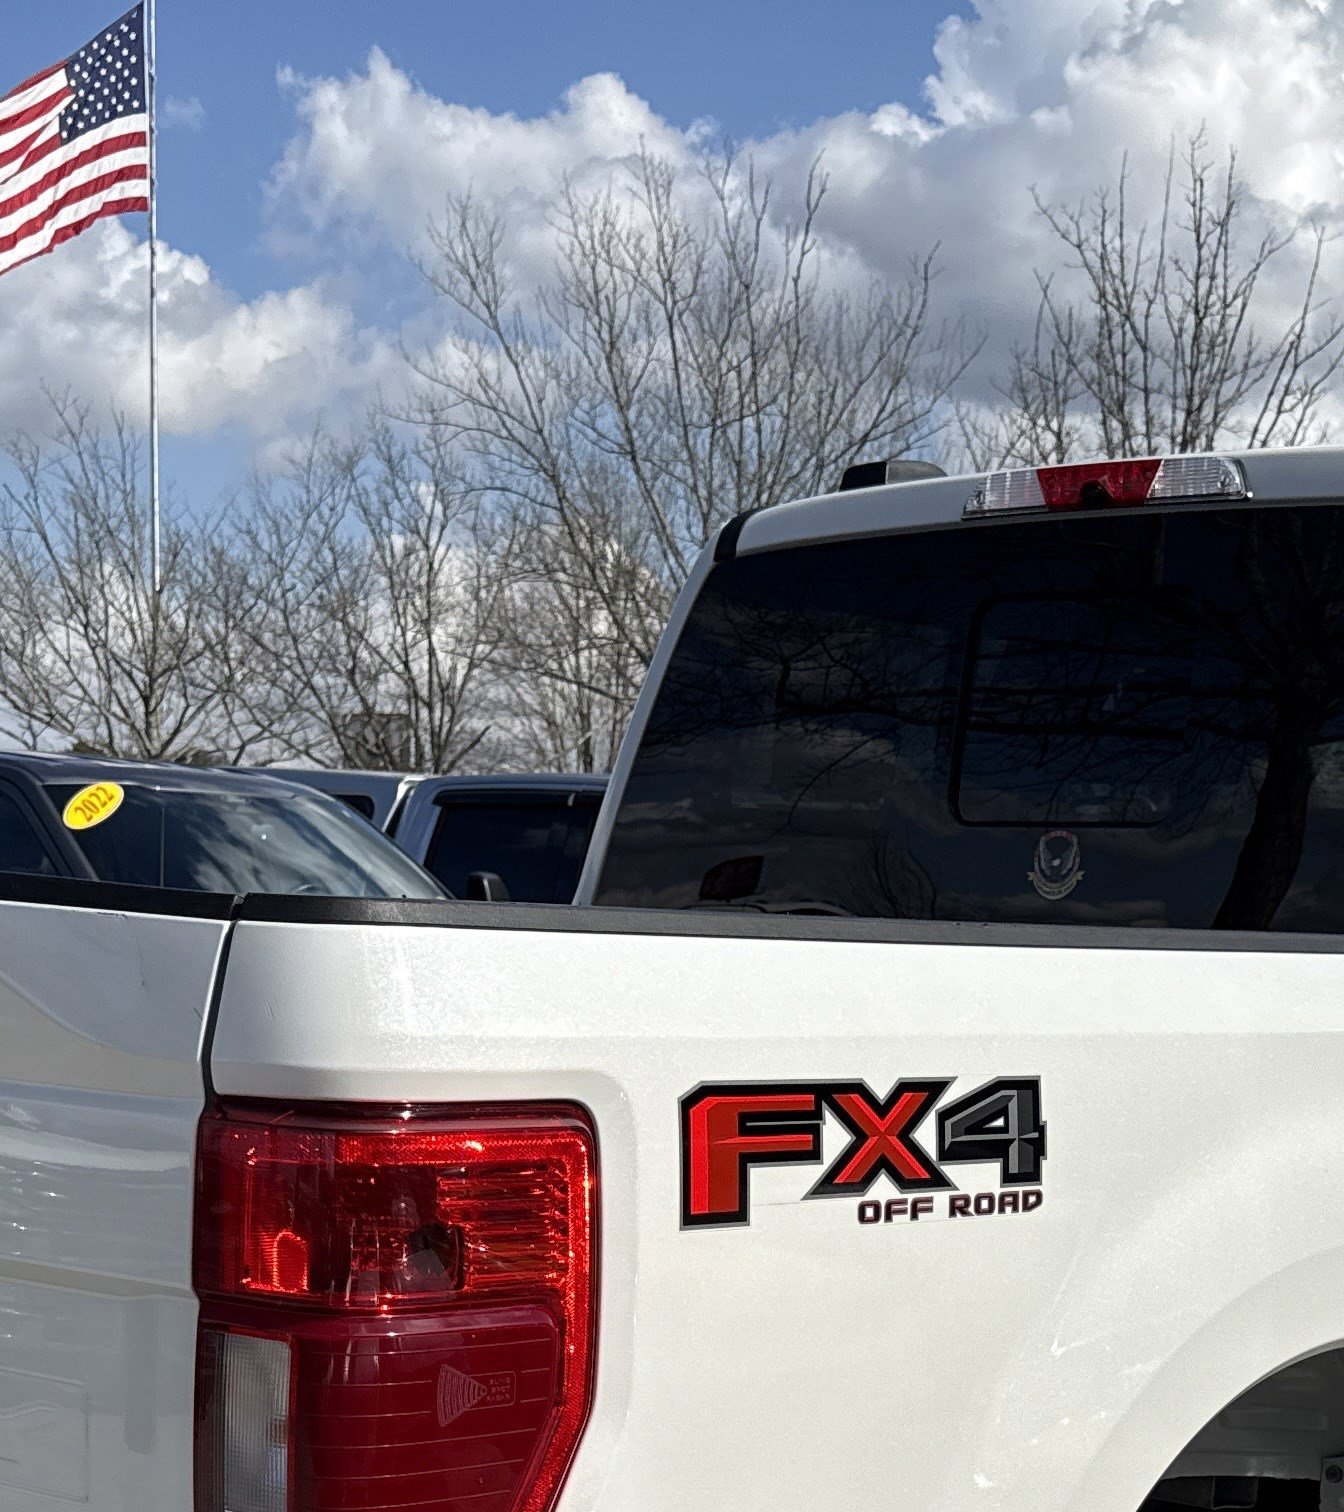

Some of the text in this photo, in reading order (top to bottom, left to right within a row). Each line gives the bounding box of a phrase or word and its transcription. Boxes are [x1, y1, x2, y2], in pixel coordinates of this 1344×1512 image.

[73, 786, 115, 822] 2022
[678, 1075, 1048, 1231] FX4
[857, 1188, 1045, 1226] OFF ROAD
